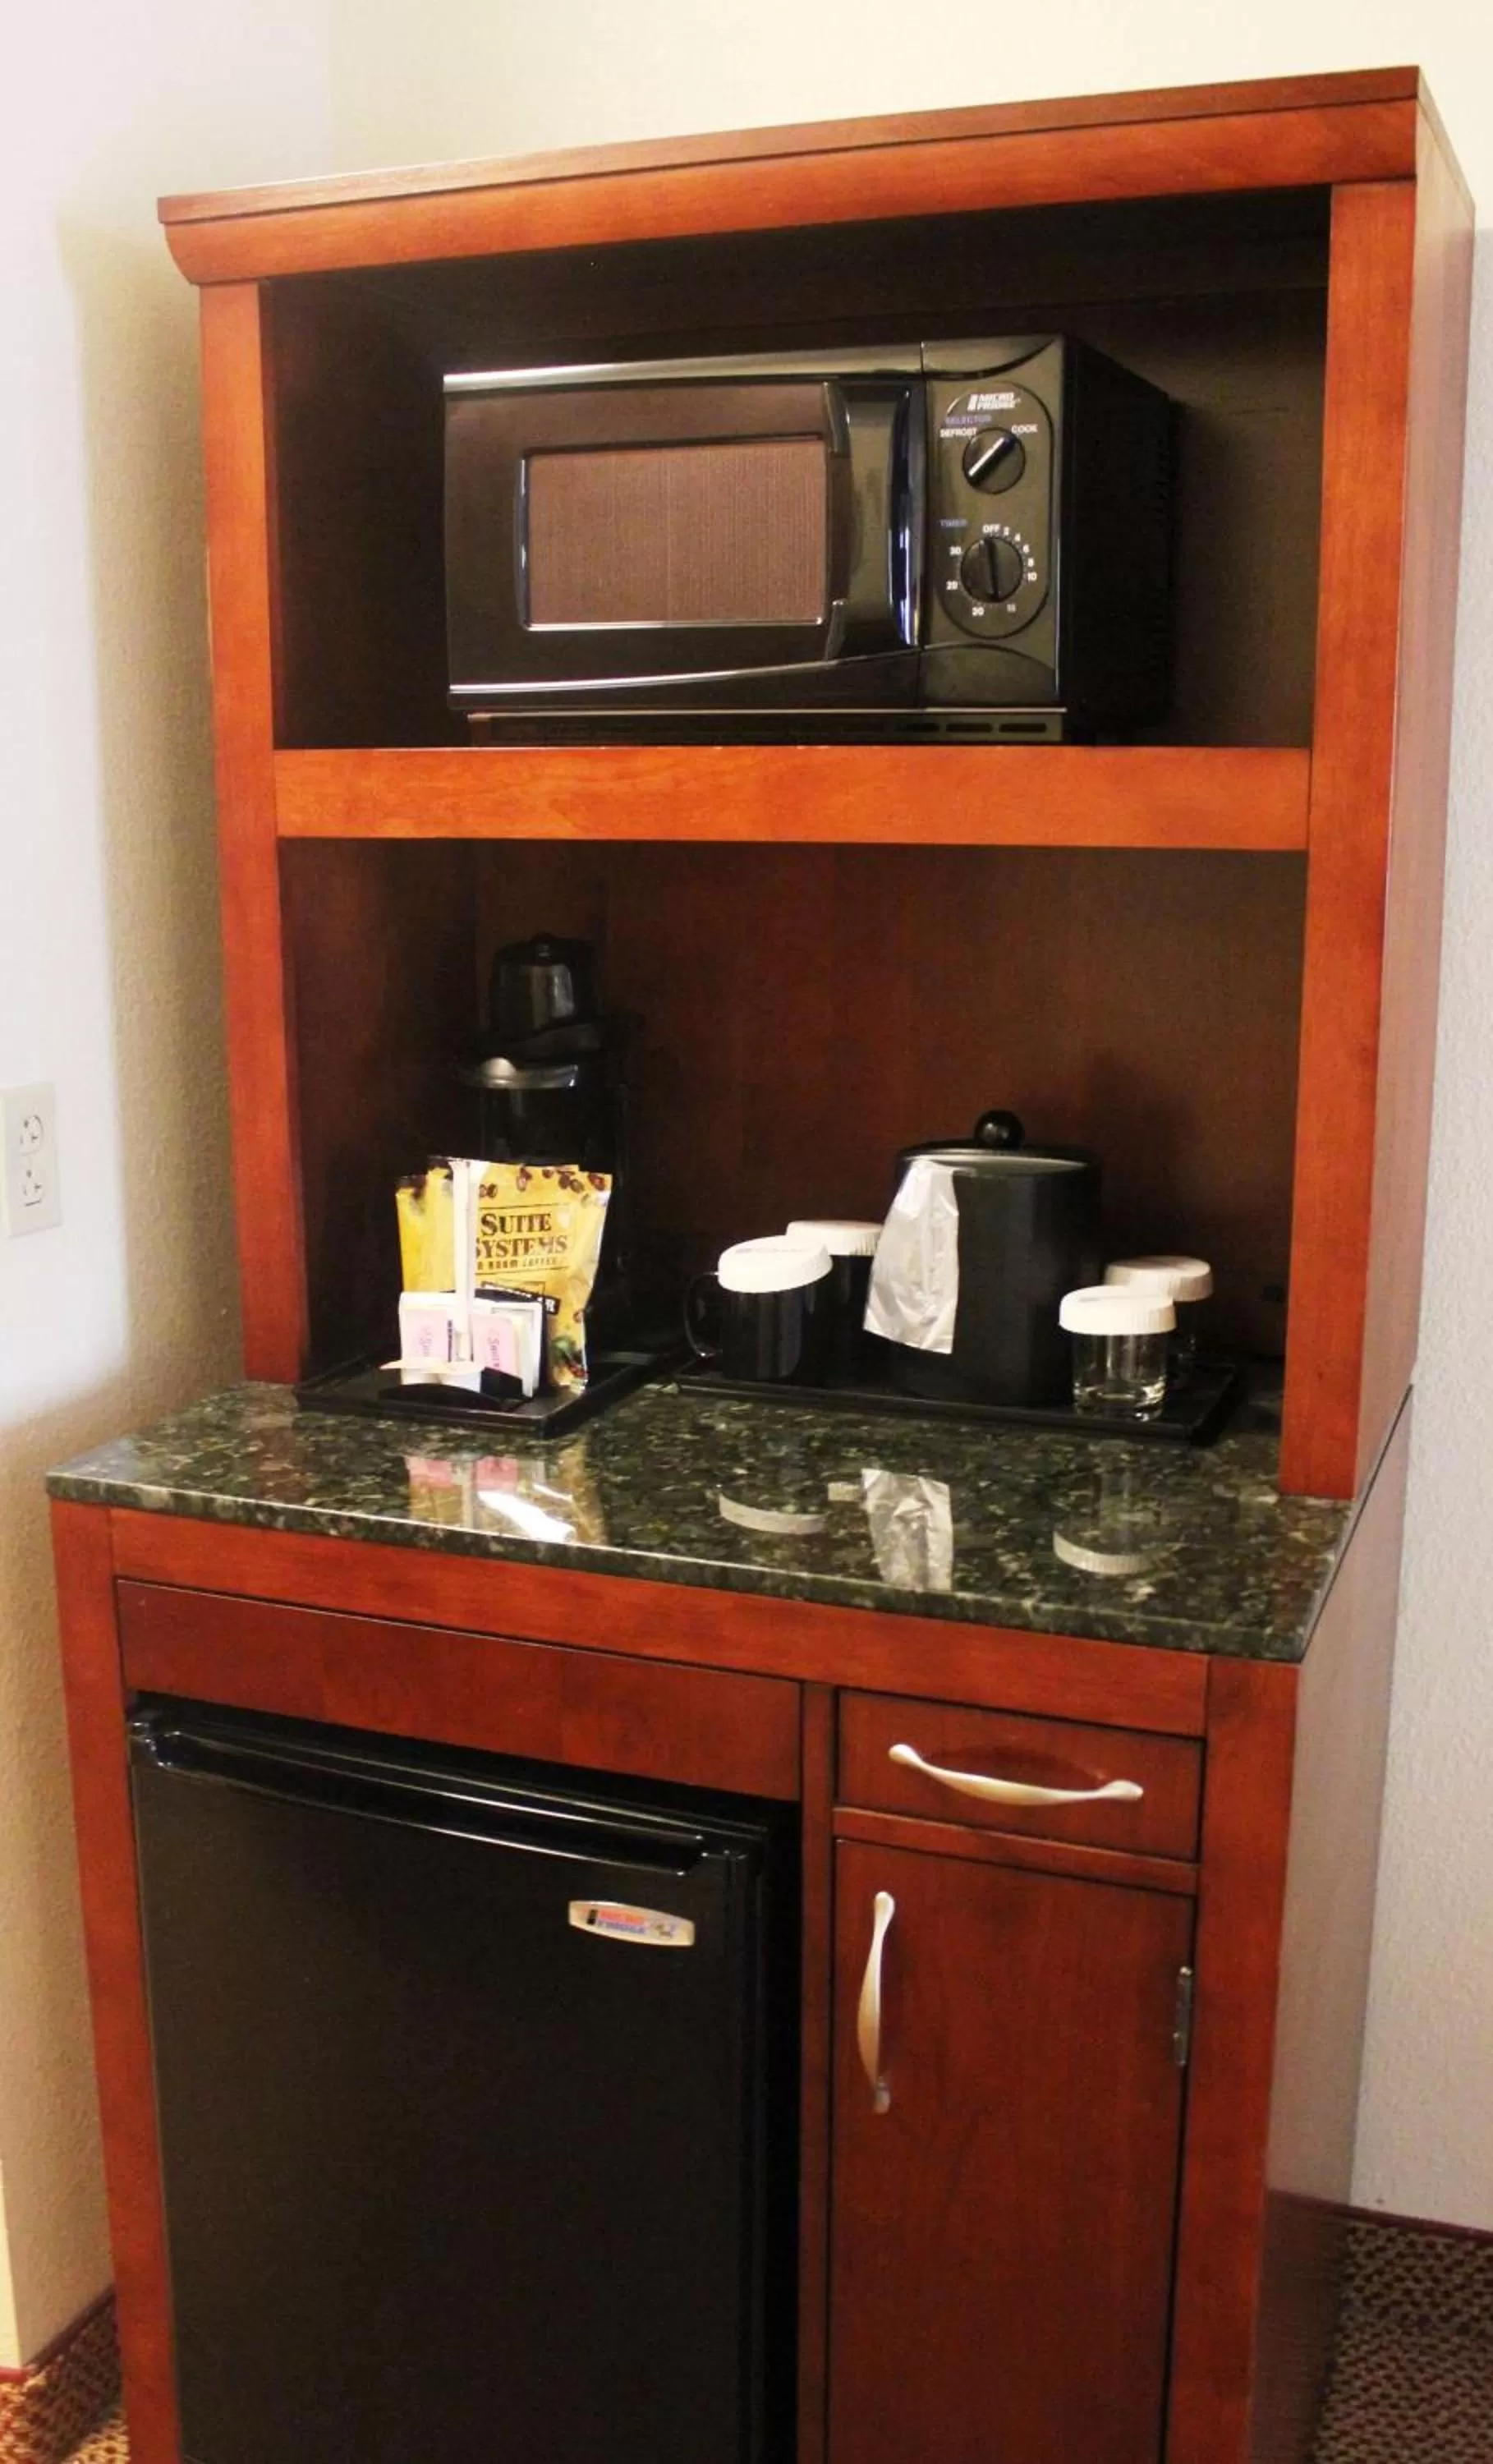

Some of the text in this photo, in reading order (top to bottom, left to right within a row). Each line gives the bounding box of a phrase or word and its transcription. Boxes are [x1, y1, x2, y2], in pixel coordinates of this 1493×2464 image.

[945, 414, 992, 425] SELECTOR
[939, 427, 977, 438] DEFROST
[1011, 424, 1038, 434] COOK
[982, 524, 1000, 533] OFF
[480, 1212, 552, 1236] SUITE
